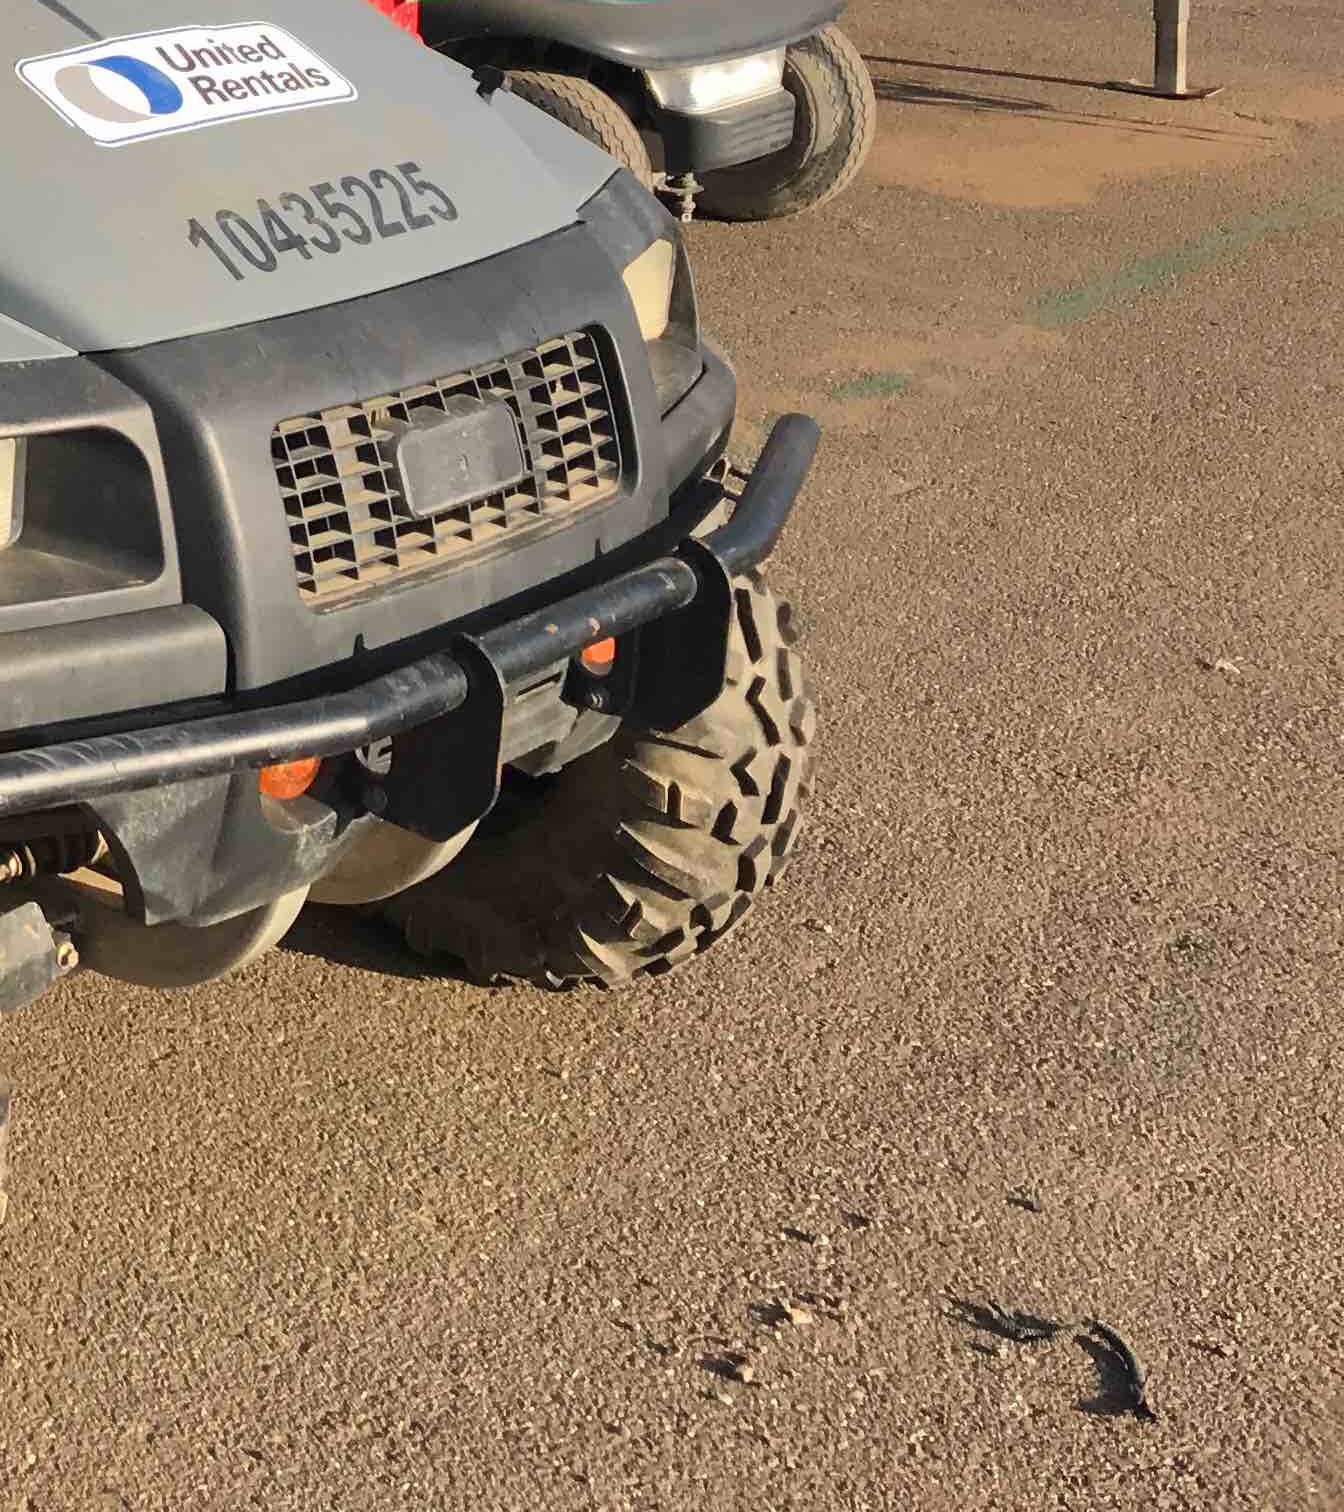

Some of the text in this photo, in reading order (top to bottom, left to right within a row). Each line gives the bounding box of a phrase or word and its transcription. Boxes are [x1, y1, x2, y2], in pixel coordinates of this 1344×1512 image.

[155, 35, 286, 73] United
[189, 62, 331, 105] Rentals
[186, 161, 459, 281] 10435225
